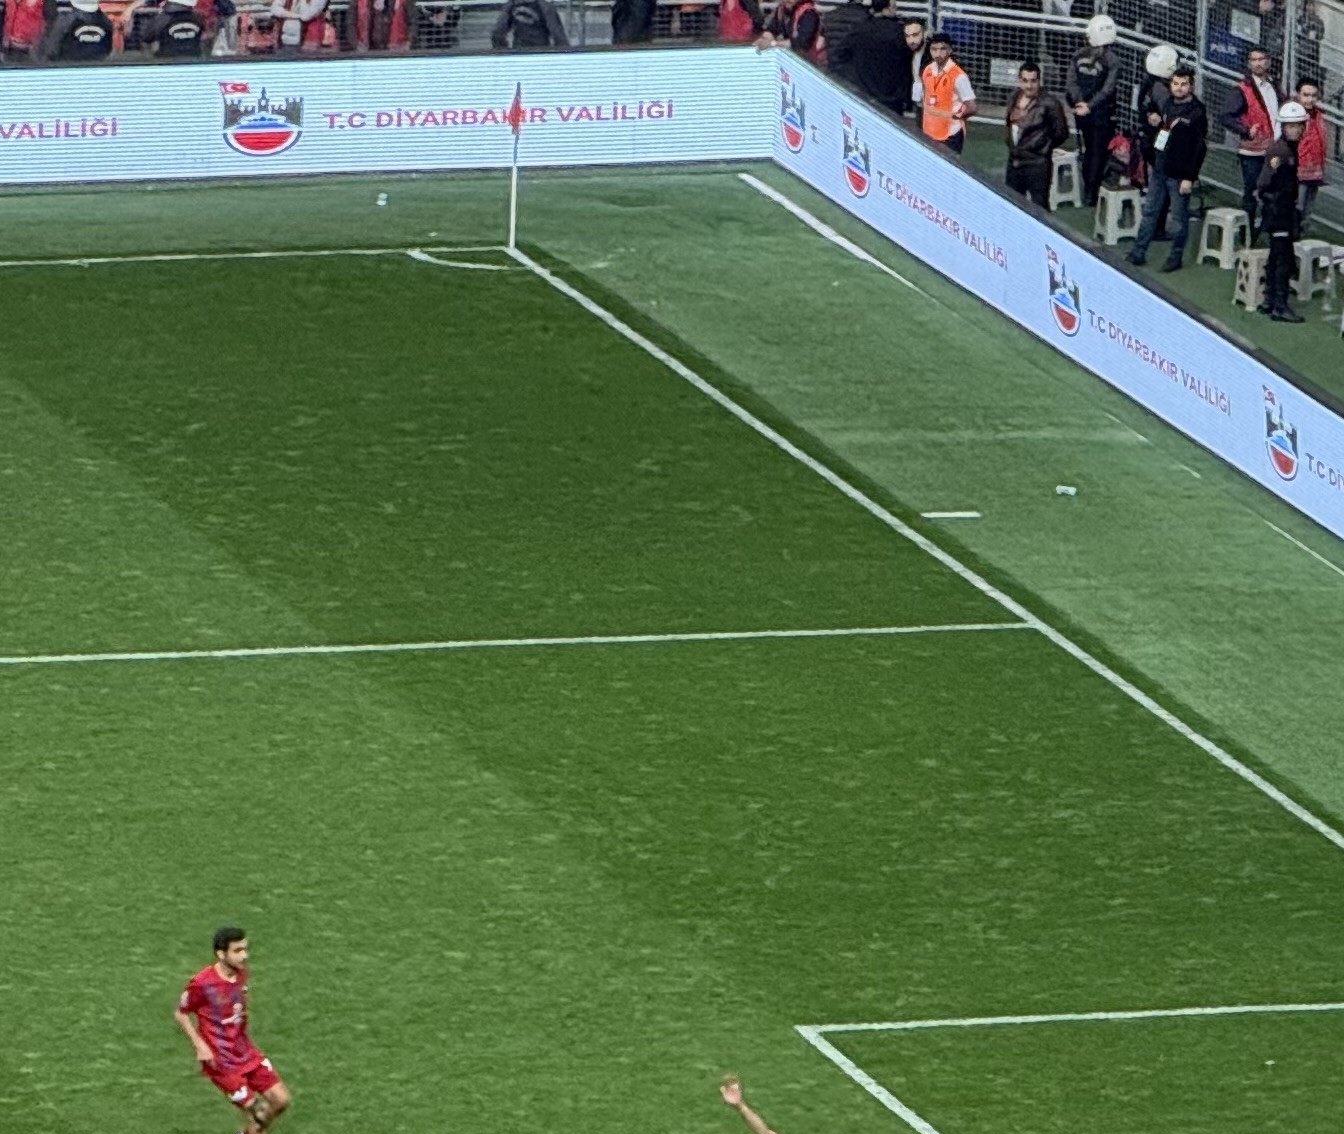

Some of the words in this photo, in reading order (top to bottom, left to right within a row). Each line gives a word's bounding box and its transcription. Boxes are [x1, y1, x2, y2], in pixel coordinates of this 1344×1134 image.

[322, 112, 366, 129] T.C
[557, 100, 674, 123] VALİLİĞİ
[1305, 452, 1326, 479] T.C
